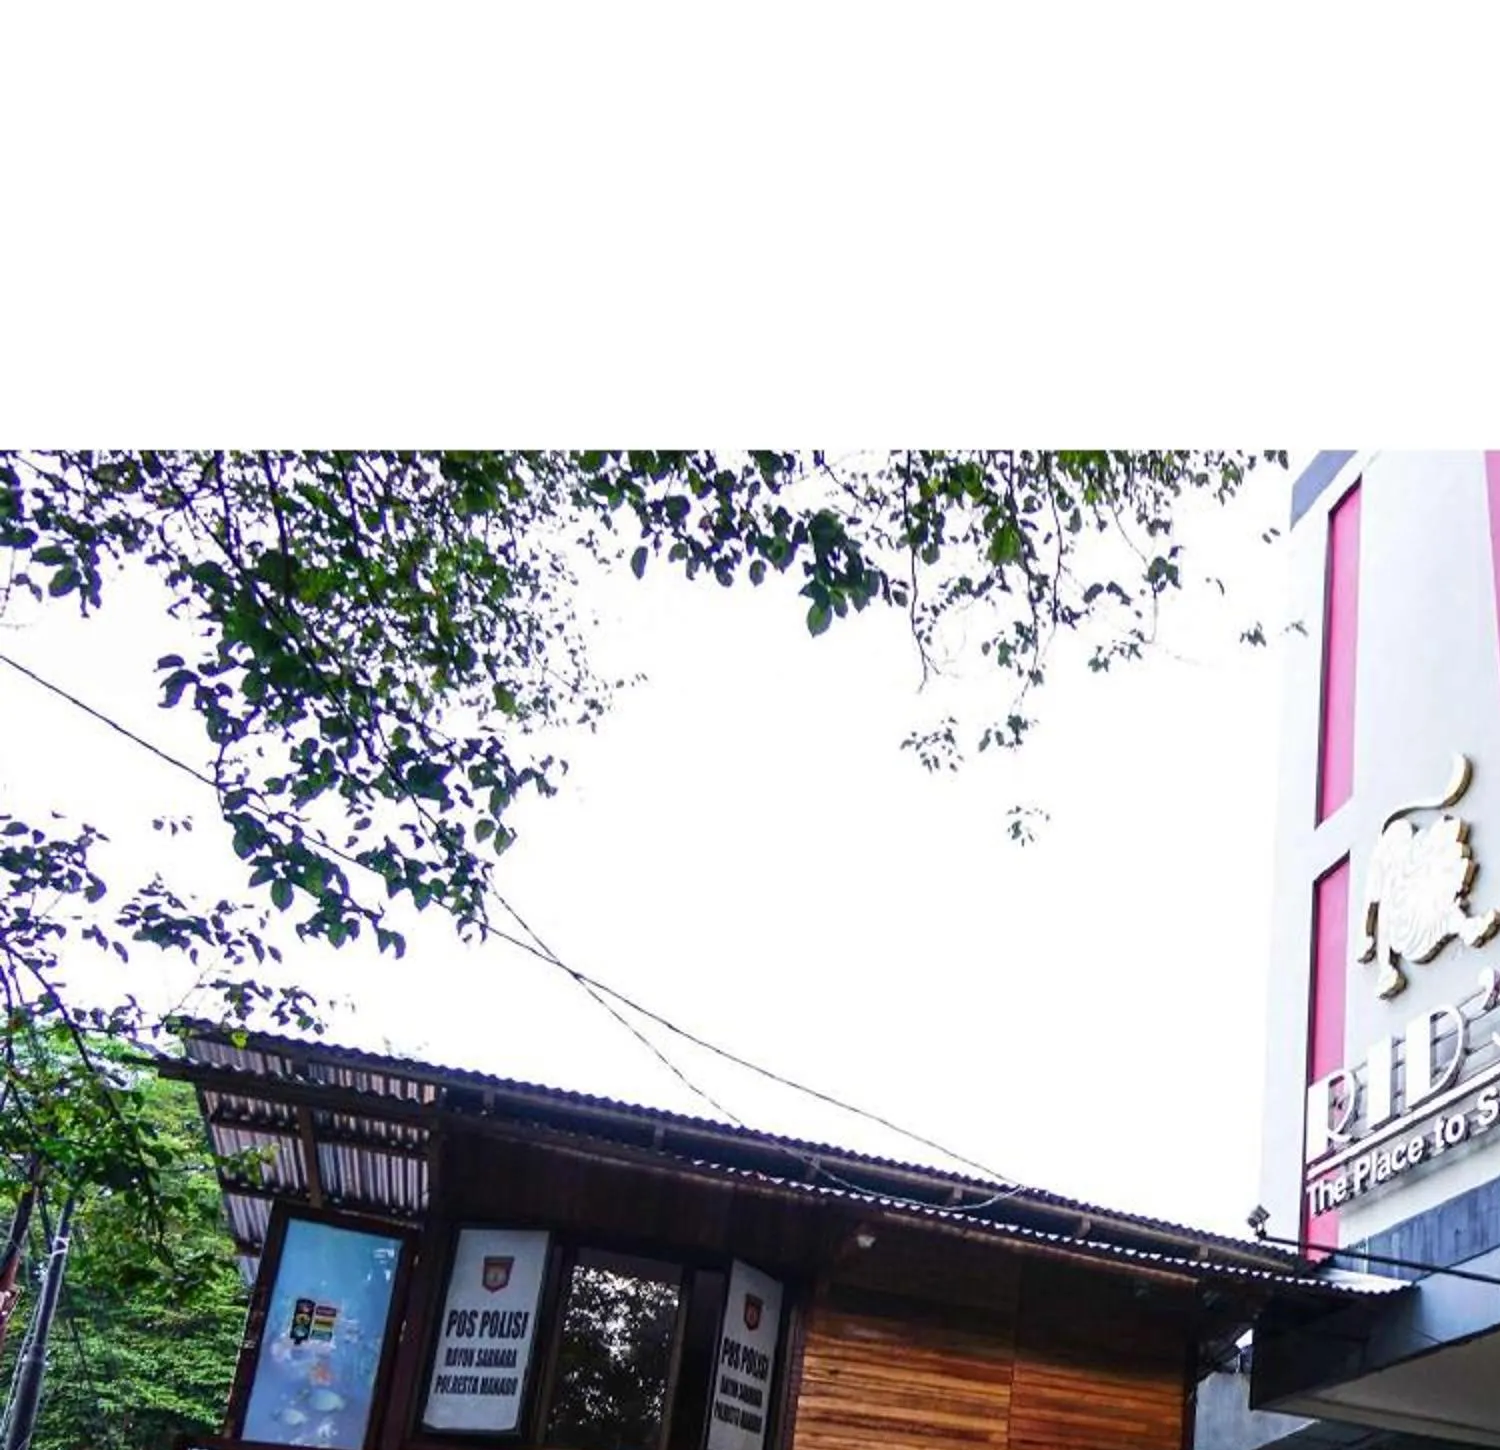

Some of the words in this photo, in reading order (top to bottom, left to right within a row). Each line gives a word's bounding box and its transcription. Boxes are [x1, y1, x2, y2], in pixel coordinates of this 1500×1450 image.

[1306, 1180, 1347, 1215] The
[1353, 1137, 1425, 1192] Place
[1432, 1115, 1466, 1148] to
[446, 1309, 479, 1338] POS
[479, 1309, 530, 1340] POLISI
